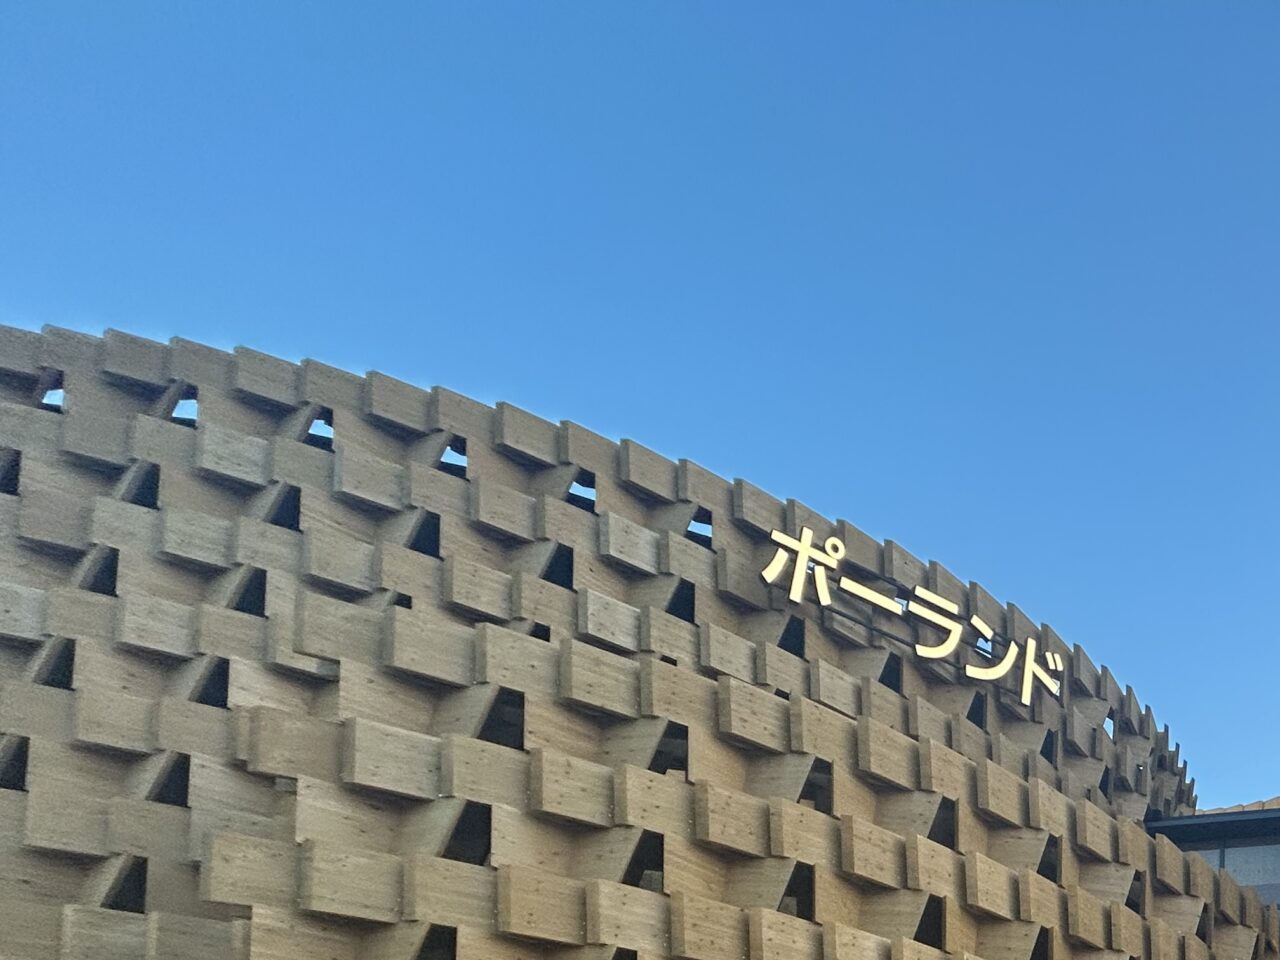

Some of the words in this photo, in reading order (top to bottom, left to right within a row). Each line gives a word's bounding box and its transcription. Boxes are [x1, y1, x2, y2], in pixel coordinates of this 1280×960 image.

[761, 526, 1064, 706] ポーランド
